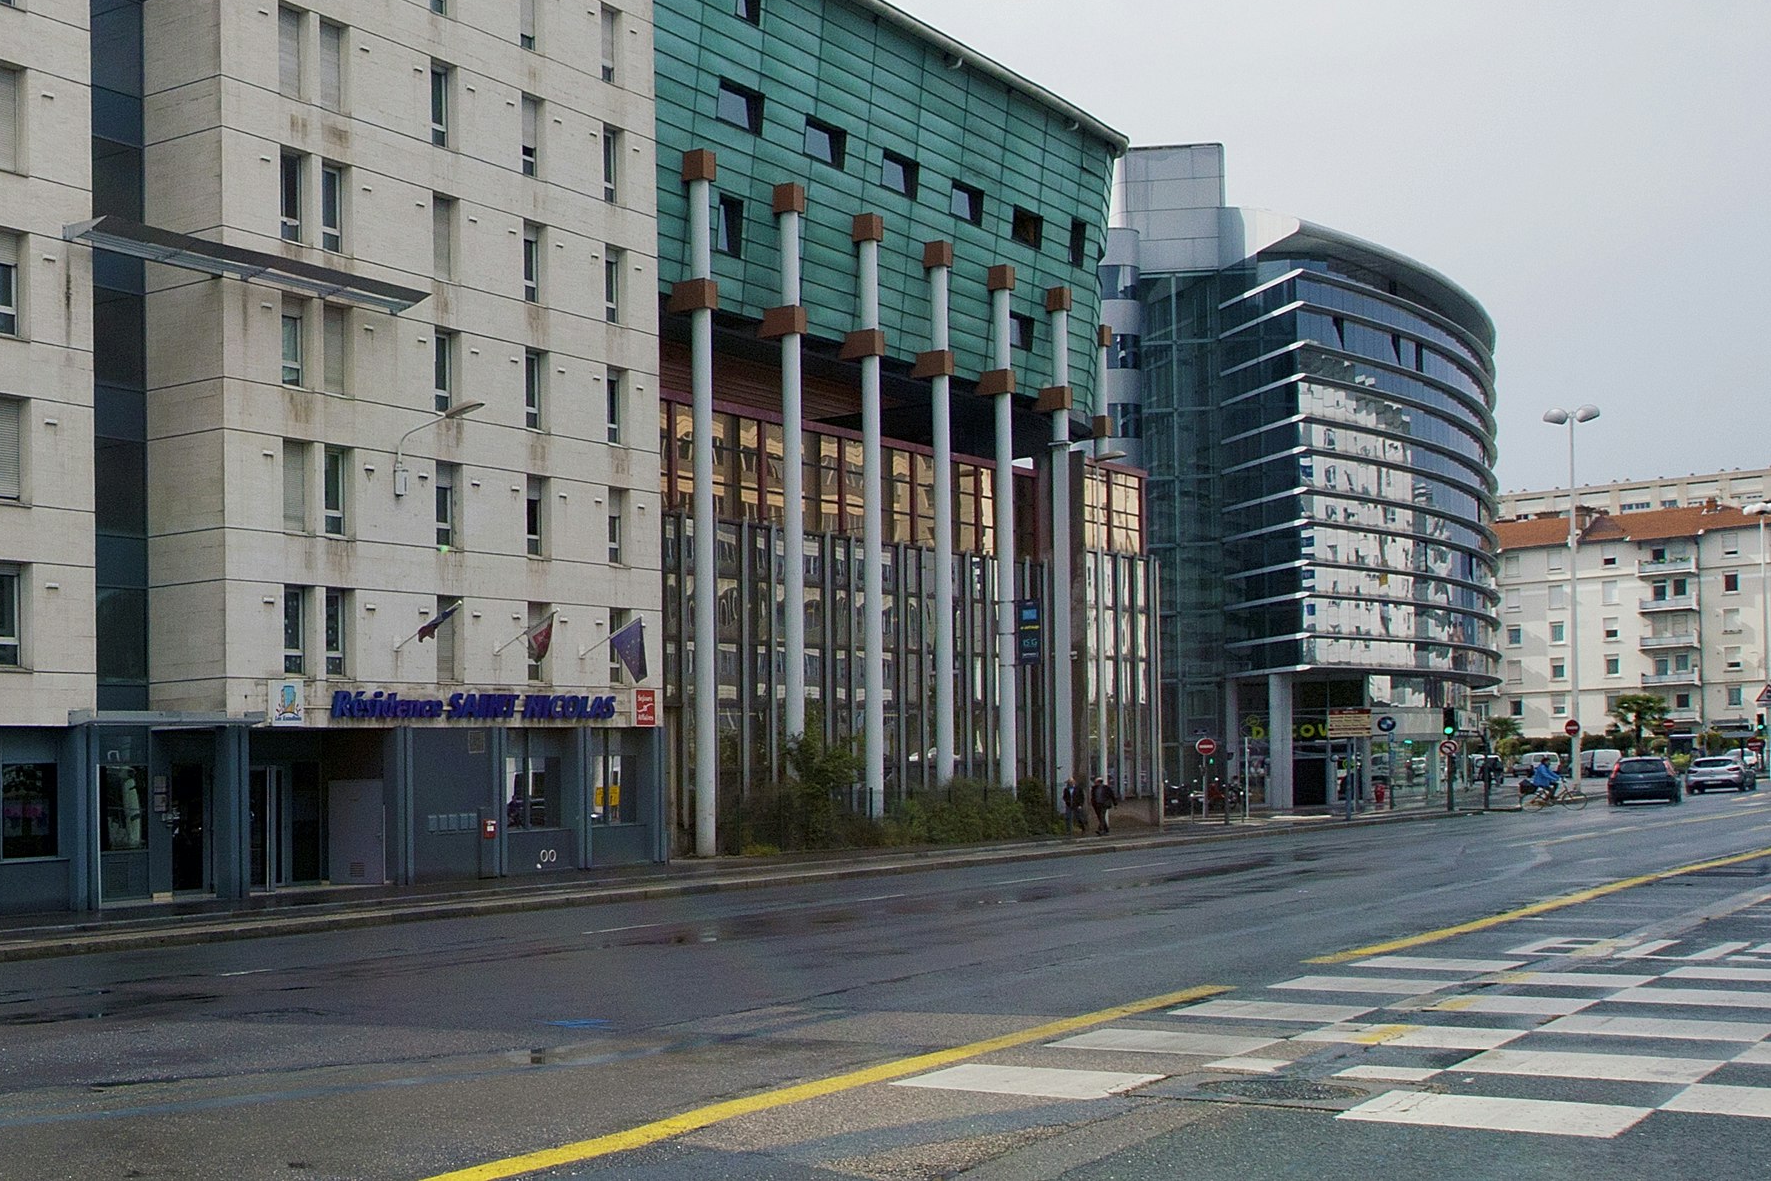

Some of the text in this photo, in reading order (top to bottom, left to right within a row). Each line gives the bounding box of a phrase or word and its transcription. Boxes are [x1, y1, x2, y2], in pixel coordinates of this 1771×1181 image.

[331, 690, 617, 720] Résidence SAINT NICOLAS
